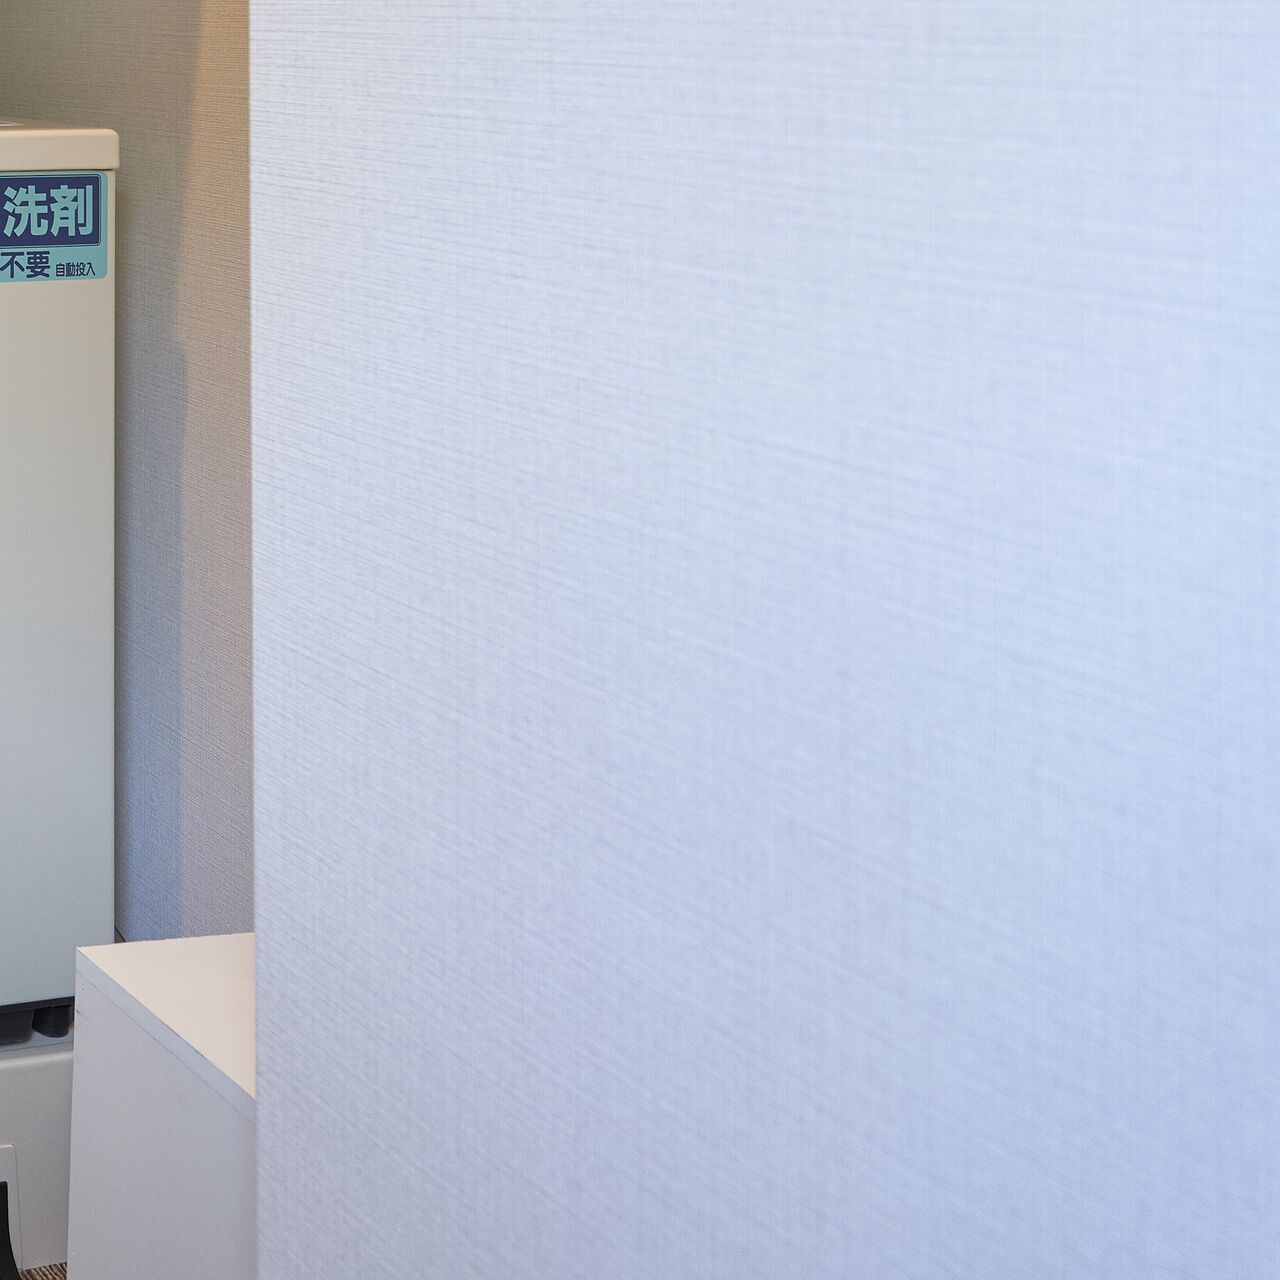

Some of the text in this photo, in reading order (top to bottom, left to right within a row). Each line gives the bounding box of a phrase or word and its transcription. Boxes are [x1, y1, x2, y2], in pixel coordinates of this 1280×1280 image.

[3, 184, 93, 237] 洗剤
[0, 251, 96, 279] 不要 自動投入
